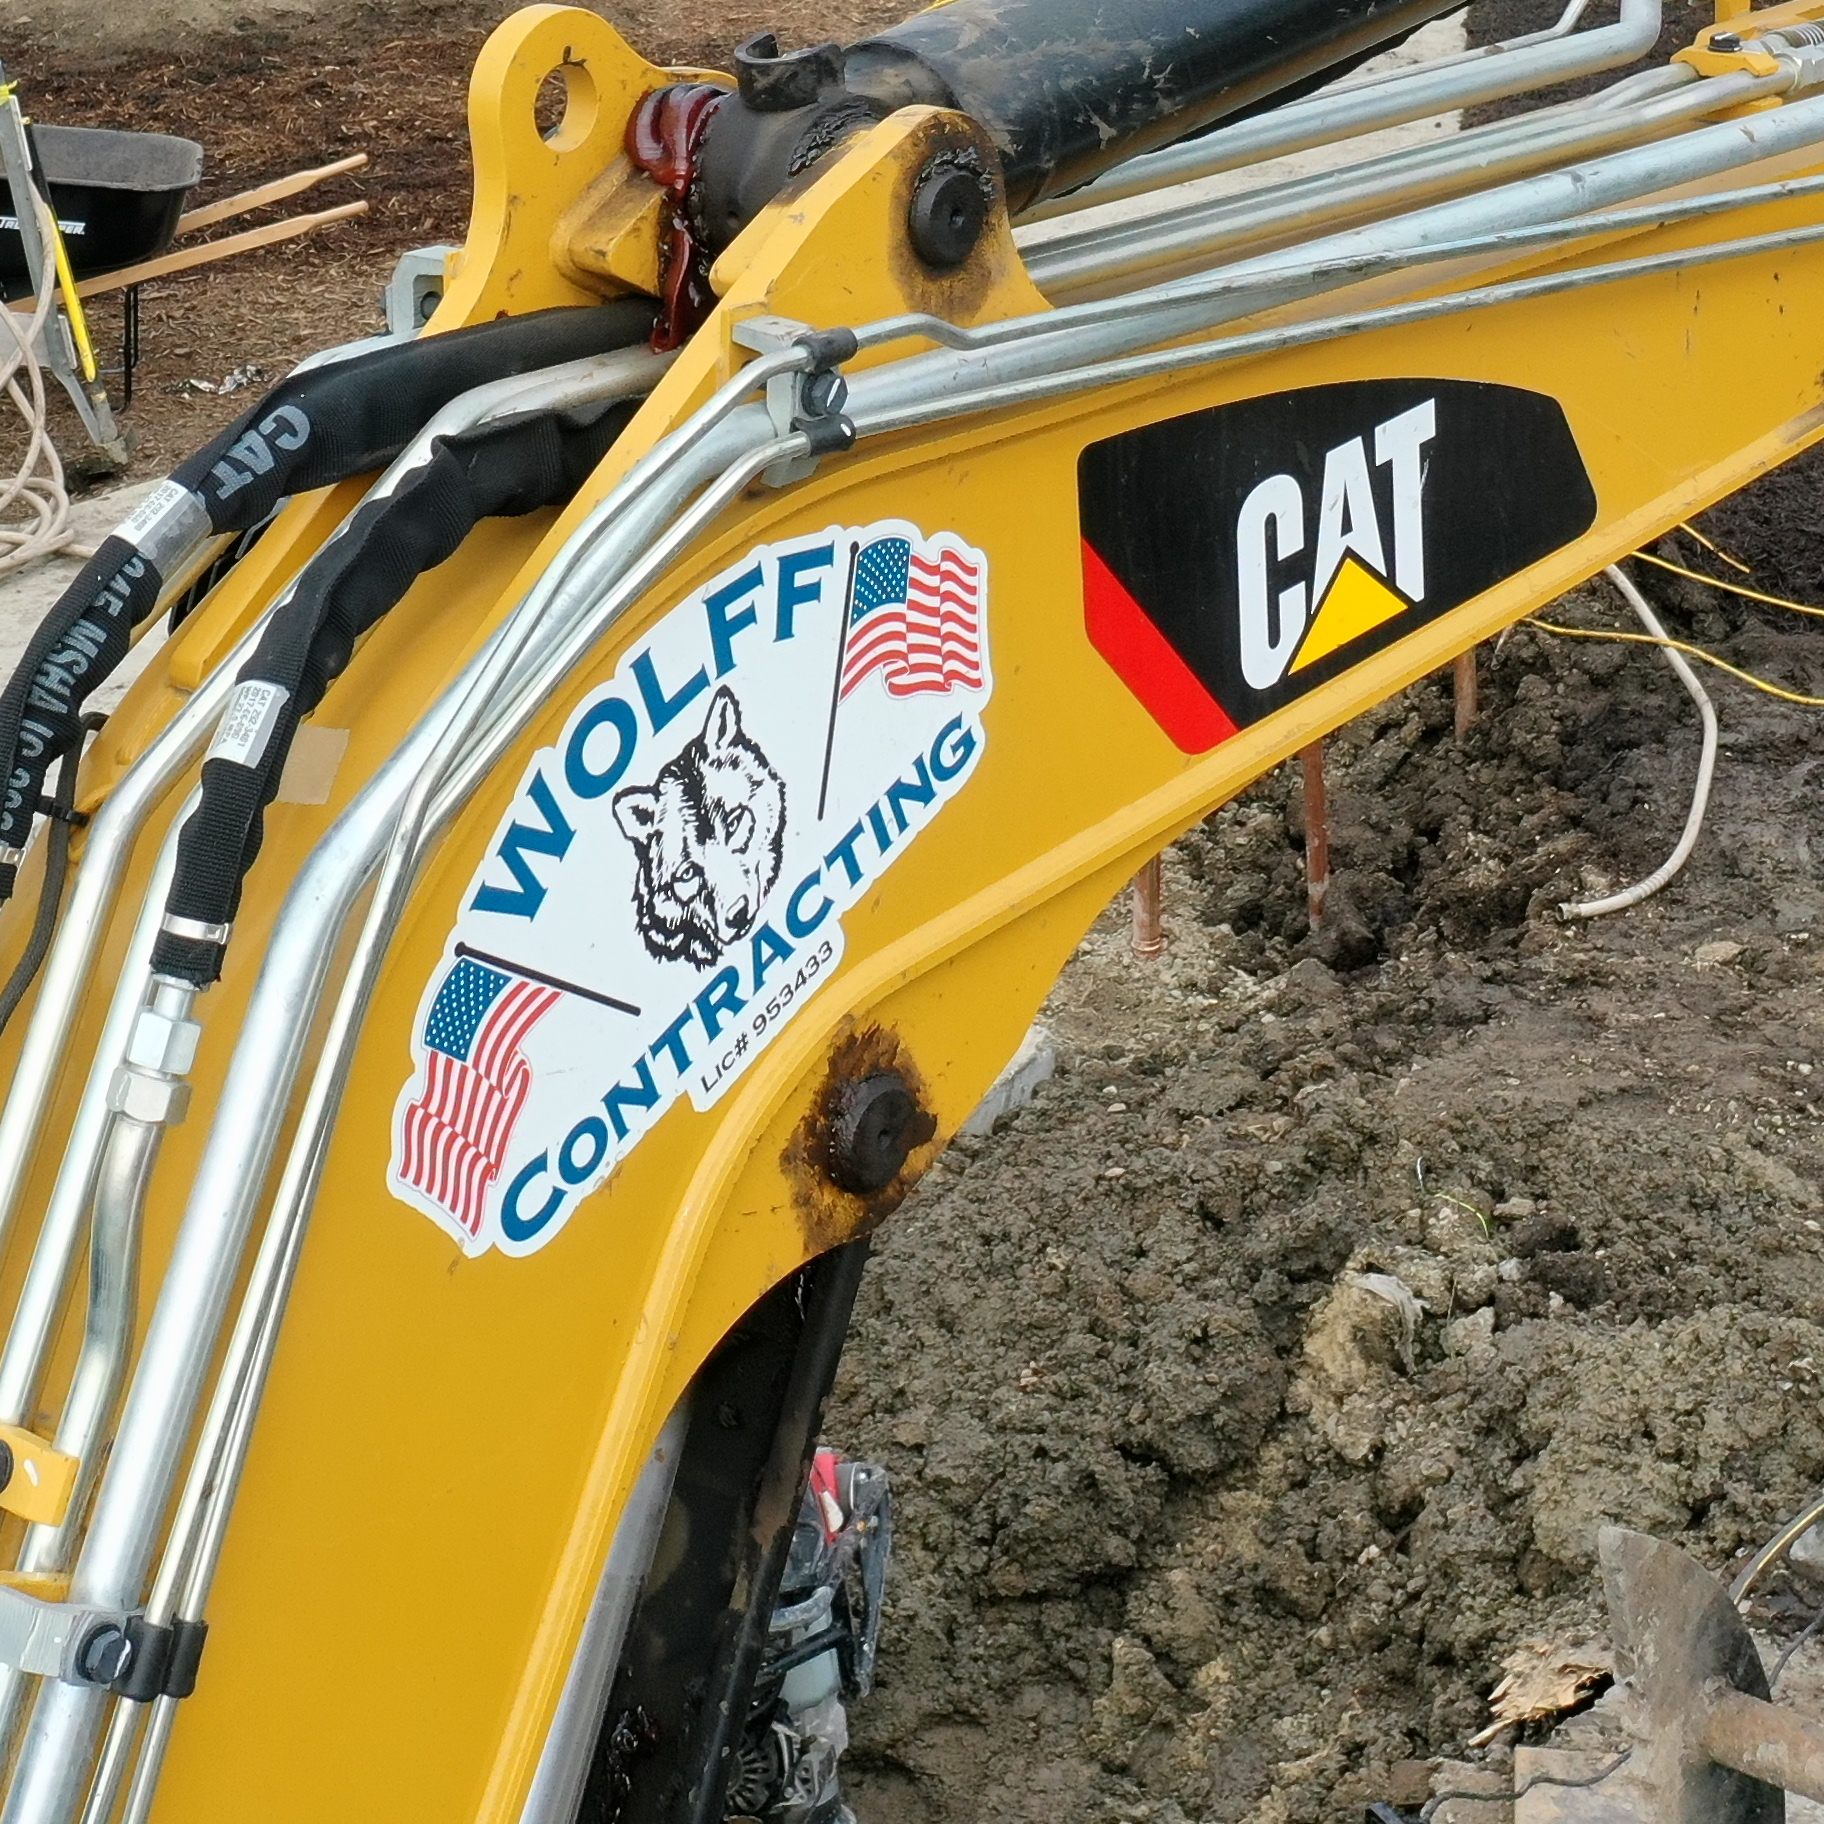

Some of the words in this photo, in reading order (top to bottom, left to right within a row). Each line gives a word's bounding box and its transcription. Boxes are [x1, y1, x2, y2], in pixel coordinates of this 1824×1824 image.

[212, 405, 311, 499] CAT
[1236, 398, 1436, 690] CAT
[28, 619, 107, 715] MSHA
[469, 540, 836, 923] WOLFF
[501, 712, 977, 1242] CONTRACTING
[700, 1031, 749, 1094] LIC#
[752, 940, 833, 1037] 953433
